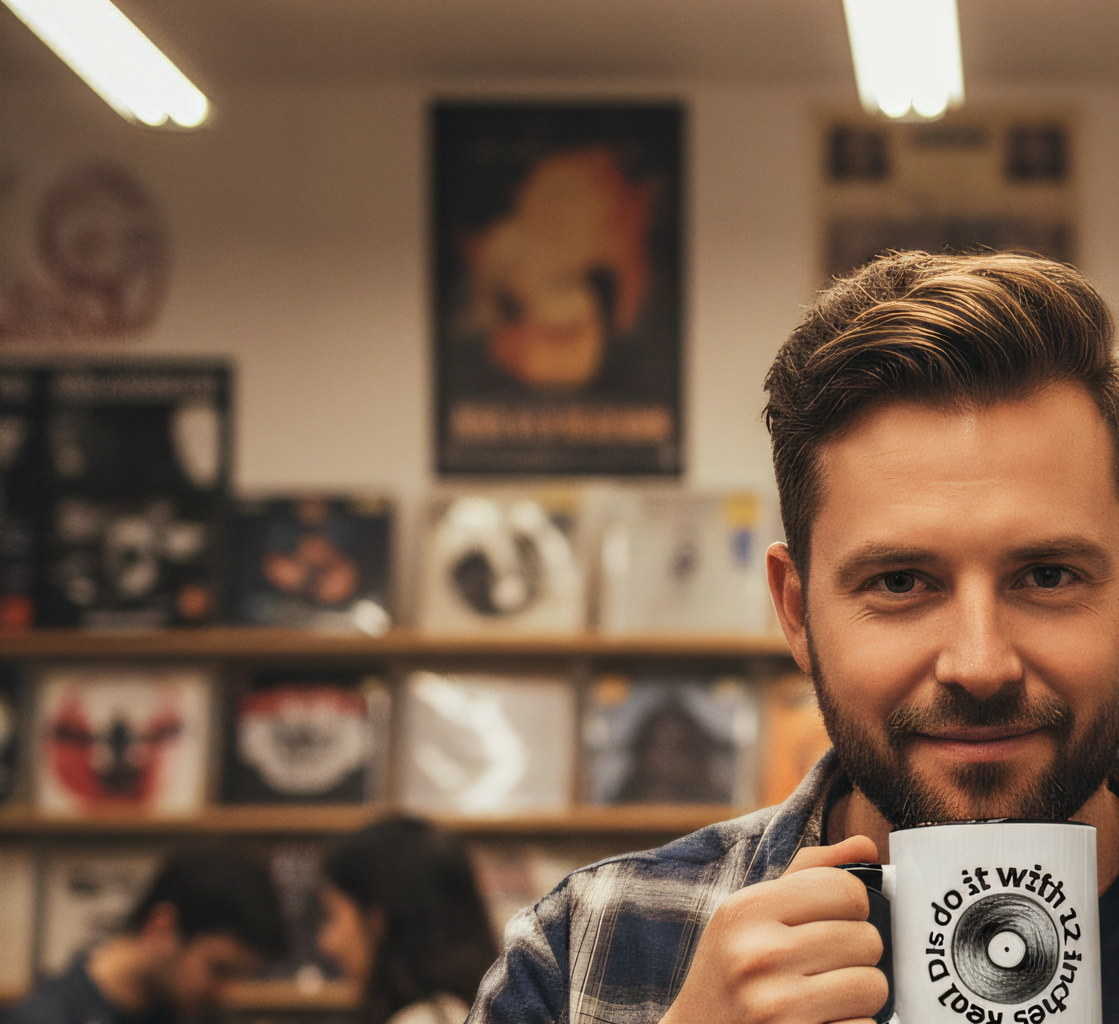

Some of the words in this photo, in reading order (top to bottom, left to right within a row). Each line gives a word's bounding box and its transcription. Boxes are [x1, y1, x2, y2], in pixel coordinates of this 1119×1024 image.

[931, 889, 964, 927] do
[961, 866, 992, 897] it
[995, 864, 1067, 909] with
[1059, 907, 1083, 947] 12
